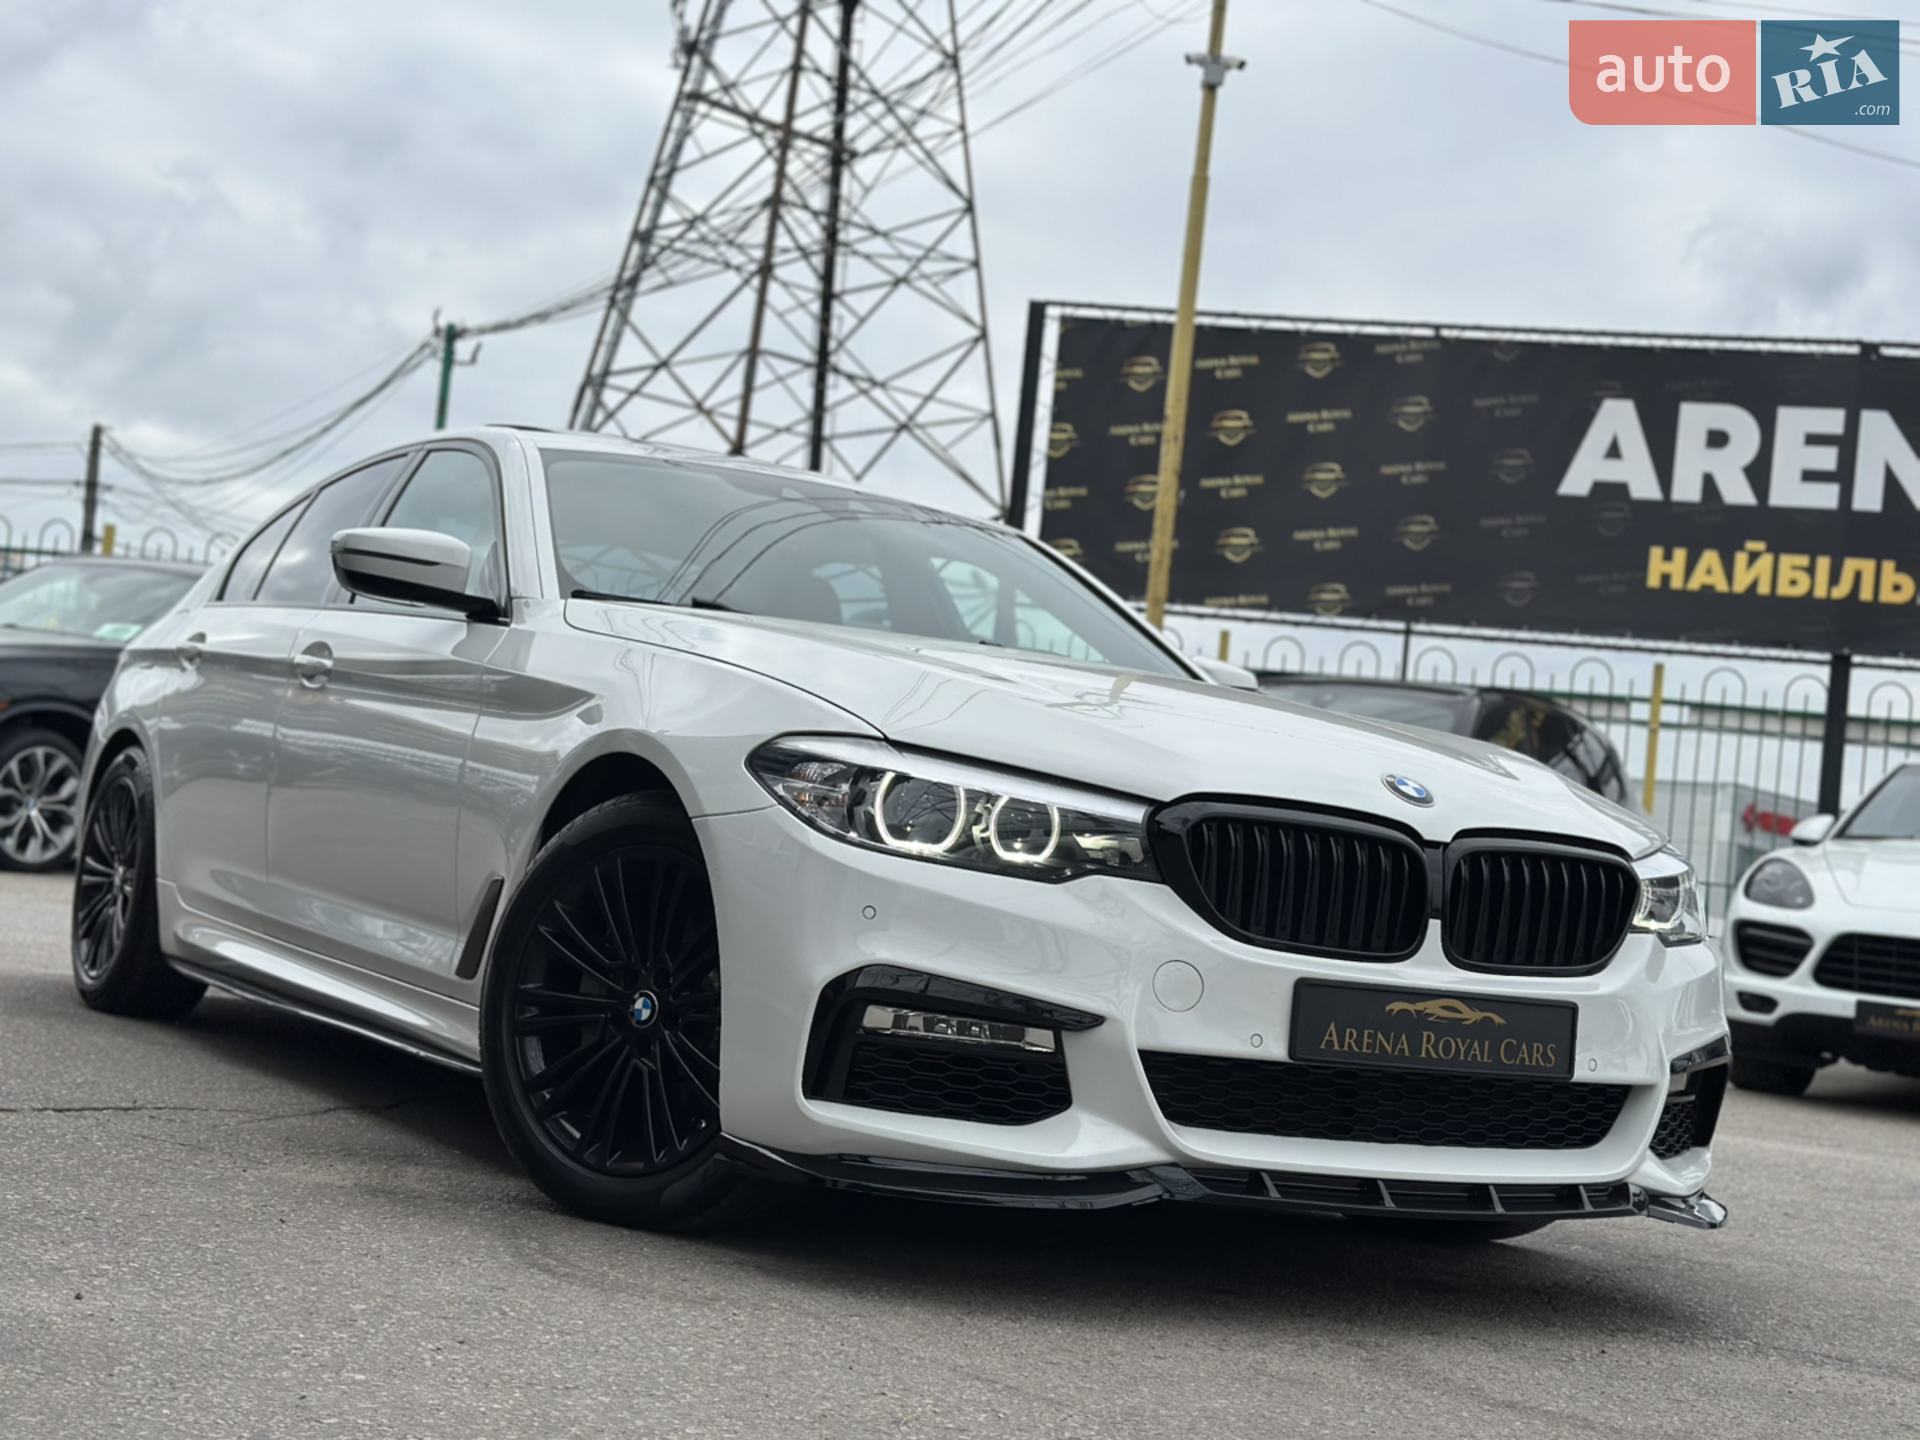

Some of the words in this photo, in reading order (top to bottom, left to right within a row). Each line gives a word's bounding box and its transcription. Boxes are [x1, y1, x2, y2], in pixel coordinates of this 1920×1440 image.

[1556, 397, 1920, 514] AREN
[1319, 1020, 1410, 1057] ARENA
[1419, 1030, 1493, 1064] ROYAL
[1500, 1038, 1557, 1068] CARS
